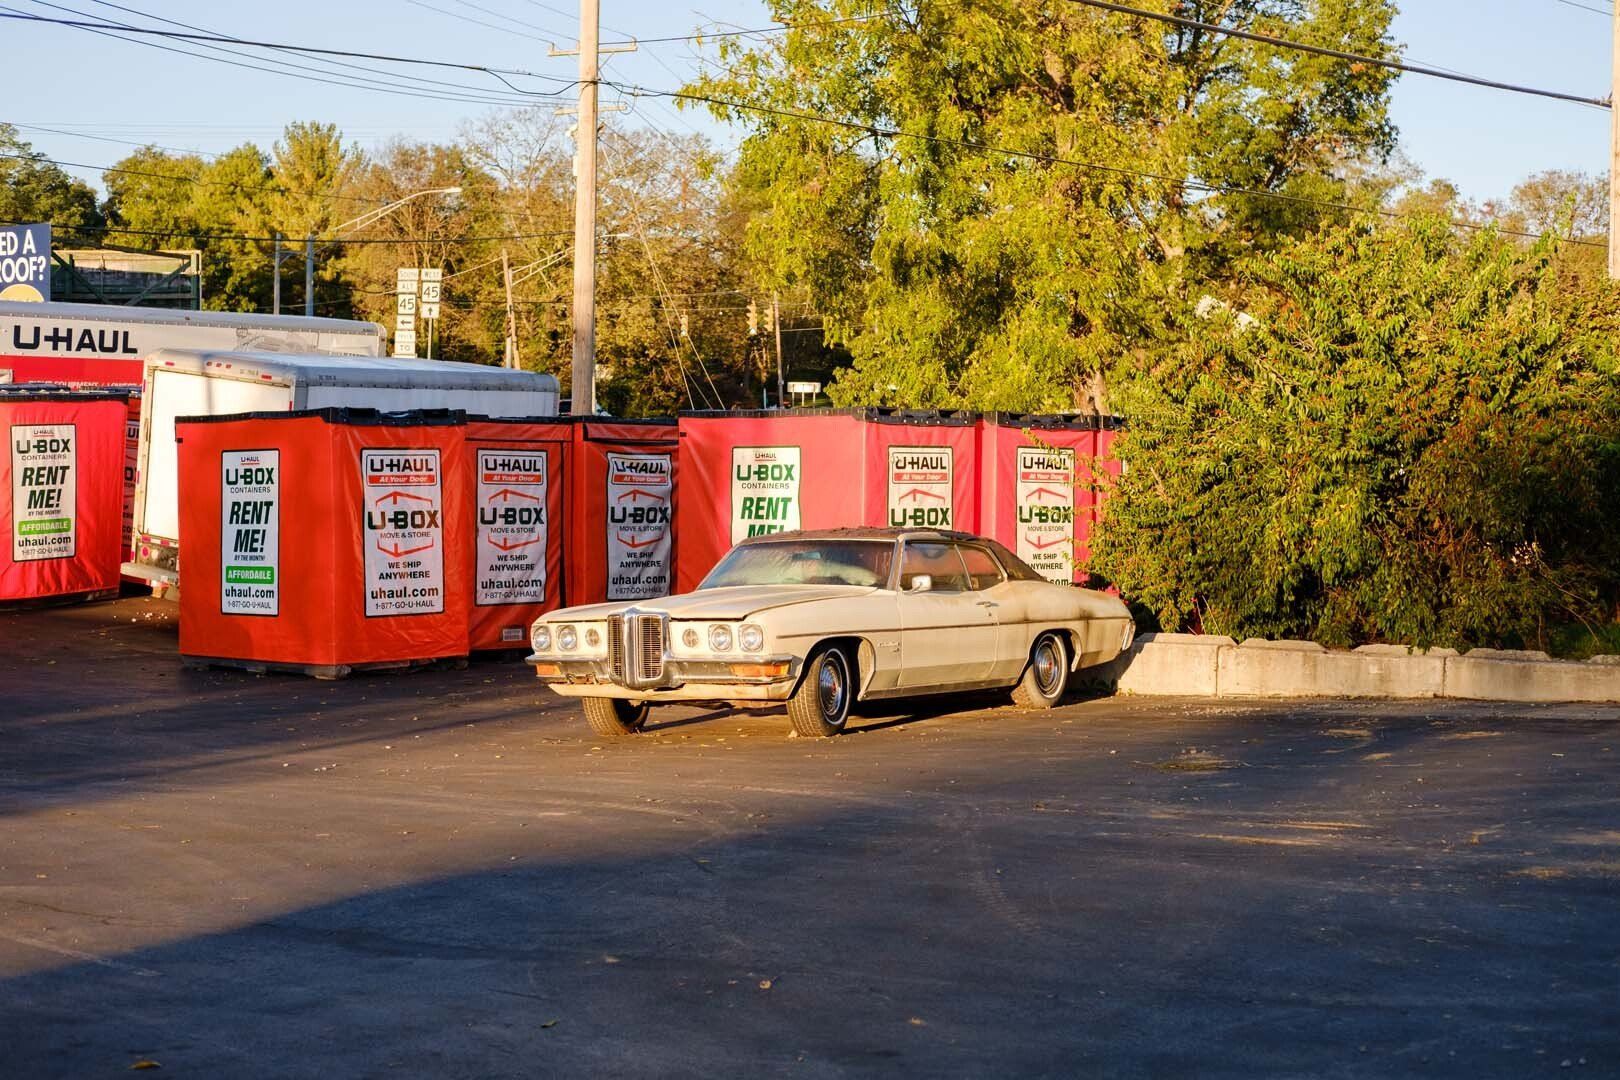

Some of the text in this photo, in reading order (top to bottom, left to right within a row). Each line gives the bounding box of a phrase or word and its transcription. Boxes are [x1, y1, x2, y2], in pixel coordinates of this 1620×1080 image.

[22, 229, 37, 255] A
[0, 255, 47, 283] OOF?
[423, 286, 439, 299] 45
[399, 298, 415, 311] 45
[13, 324, 138, 354] U-HAUL
[16, 438, 71, 454] U-BOX
[370, 458, 434, 473] U-HAUL
[484, 458, 541, 472] U-HAUL
[615, 460, 666, 473] U-HAUL
[895, 456, 948, 470] U-HAUL
[21, 465, 70, 487] RENT
[225, 467, 275, 486] U-BOX
[737, 464, 795, 481] U-BOX
[230, 486, 271, 494] CONTAINERS
[741, 482, 790, 490] CONTAINERS
[27, 488, 62, 510] ME!
[229, 500, 274, 525] RENT
[610, 506, 670, 524] U-BOX
[740, 496, 793, 521] RENT
[1018, 505, 1072, 524] U-BOX
[367, 510, 440, 530] U-BOX
[479, 507, 545, 525] U-BOX
[890, 507, 951, 527] U-BOX
[21, 520, 69, 532] AFFORDABLE
[18, 535, 72, 547] uhaul.com
[233, 529, 267, 553] ME!
[388, 561, 422, 569] WE SHIP
[489, 563, 535, 571] ANYWHERE
[619, 560, 662, 568] ANYWHERE
[1027, 562, 1064, 570] NYWHERE
[227, 569, 272, 580] AFFORDABLE
[379, 570, 431, 580] ANYWHERE
[612, 573, 667, 585] uhaul.com
[481, 578, 542, 589] uhaul.com
[225, 586, 275, 599] uhaul.com
[371, 586, 439, 600] uhaul.com
[484, 591, 538, 599] 1-877-GO-U-HAUL
[227, 600, 272, 609] 1-877-GO-U-HAUL
[375, 600, 435, 610] 1-877-GO-U-HAUL
